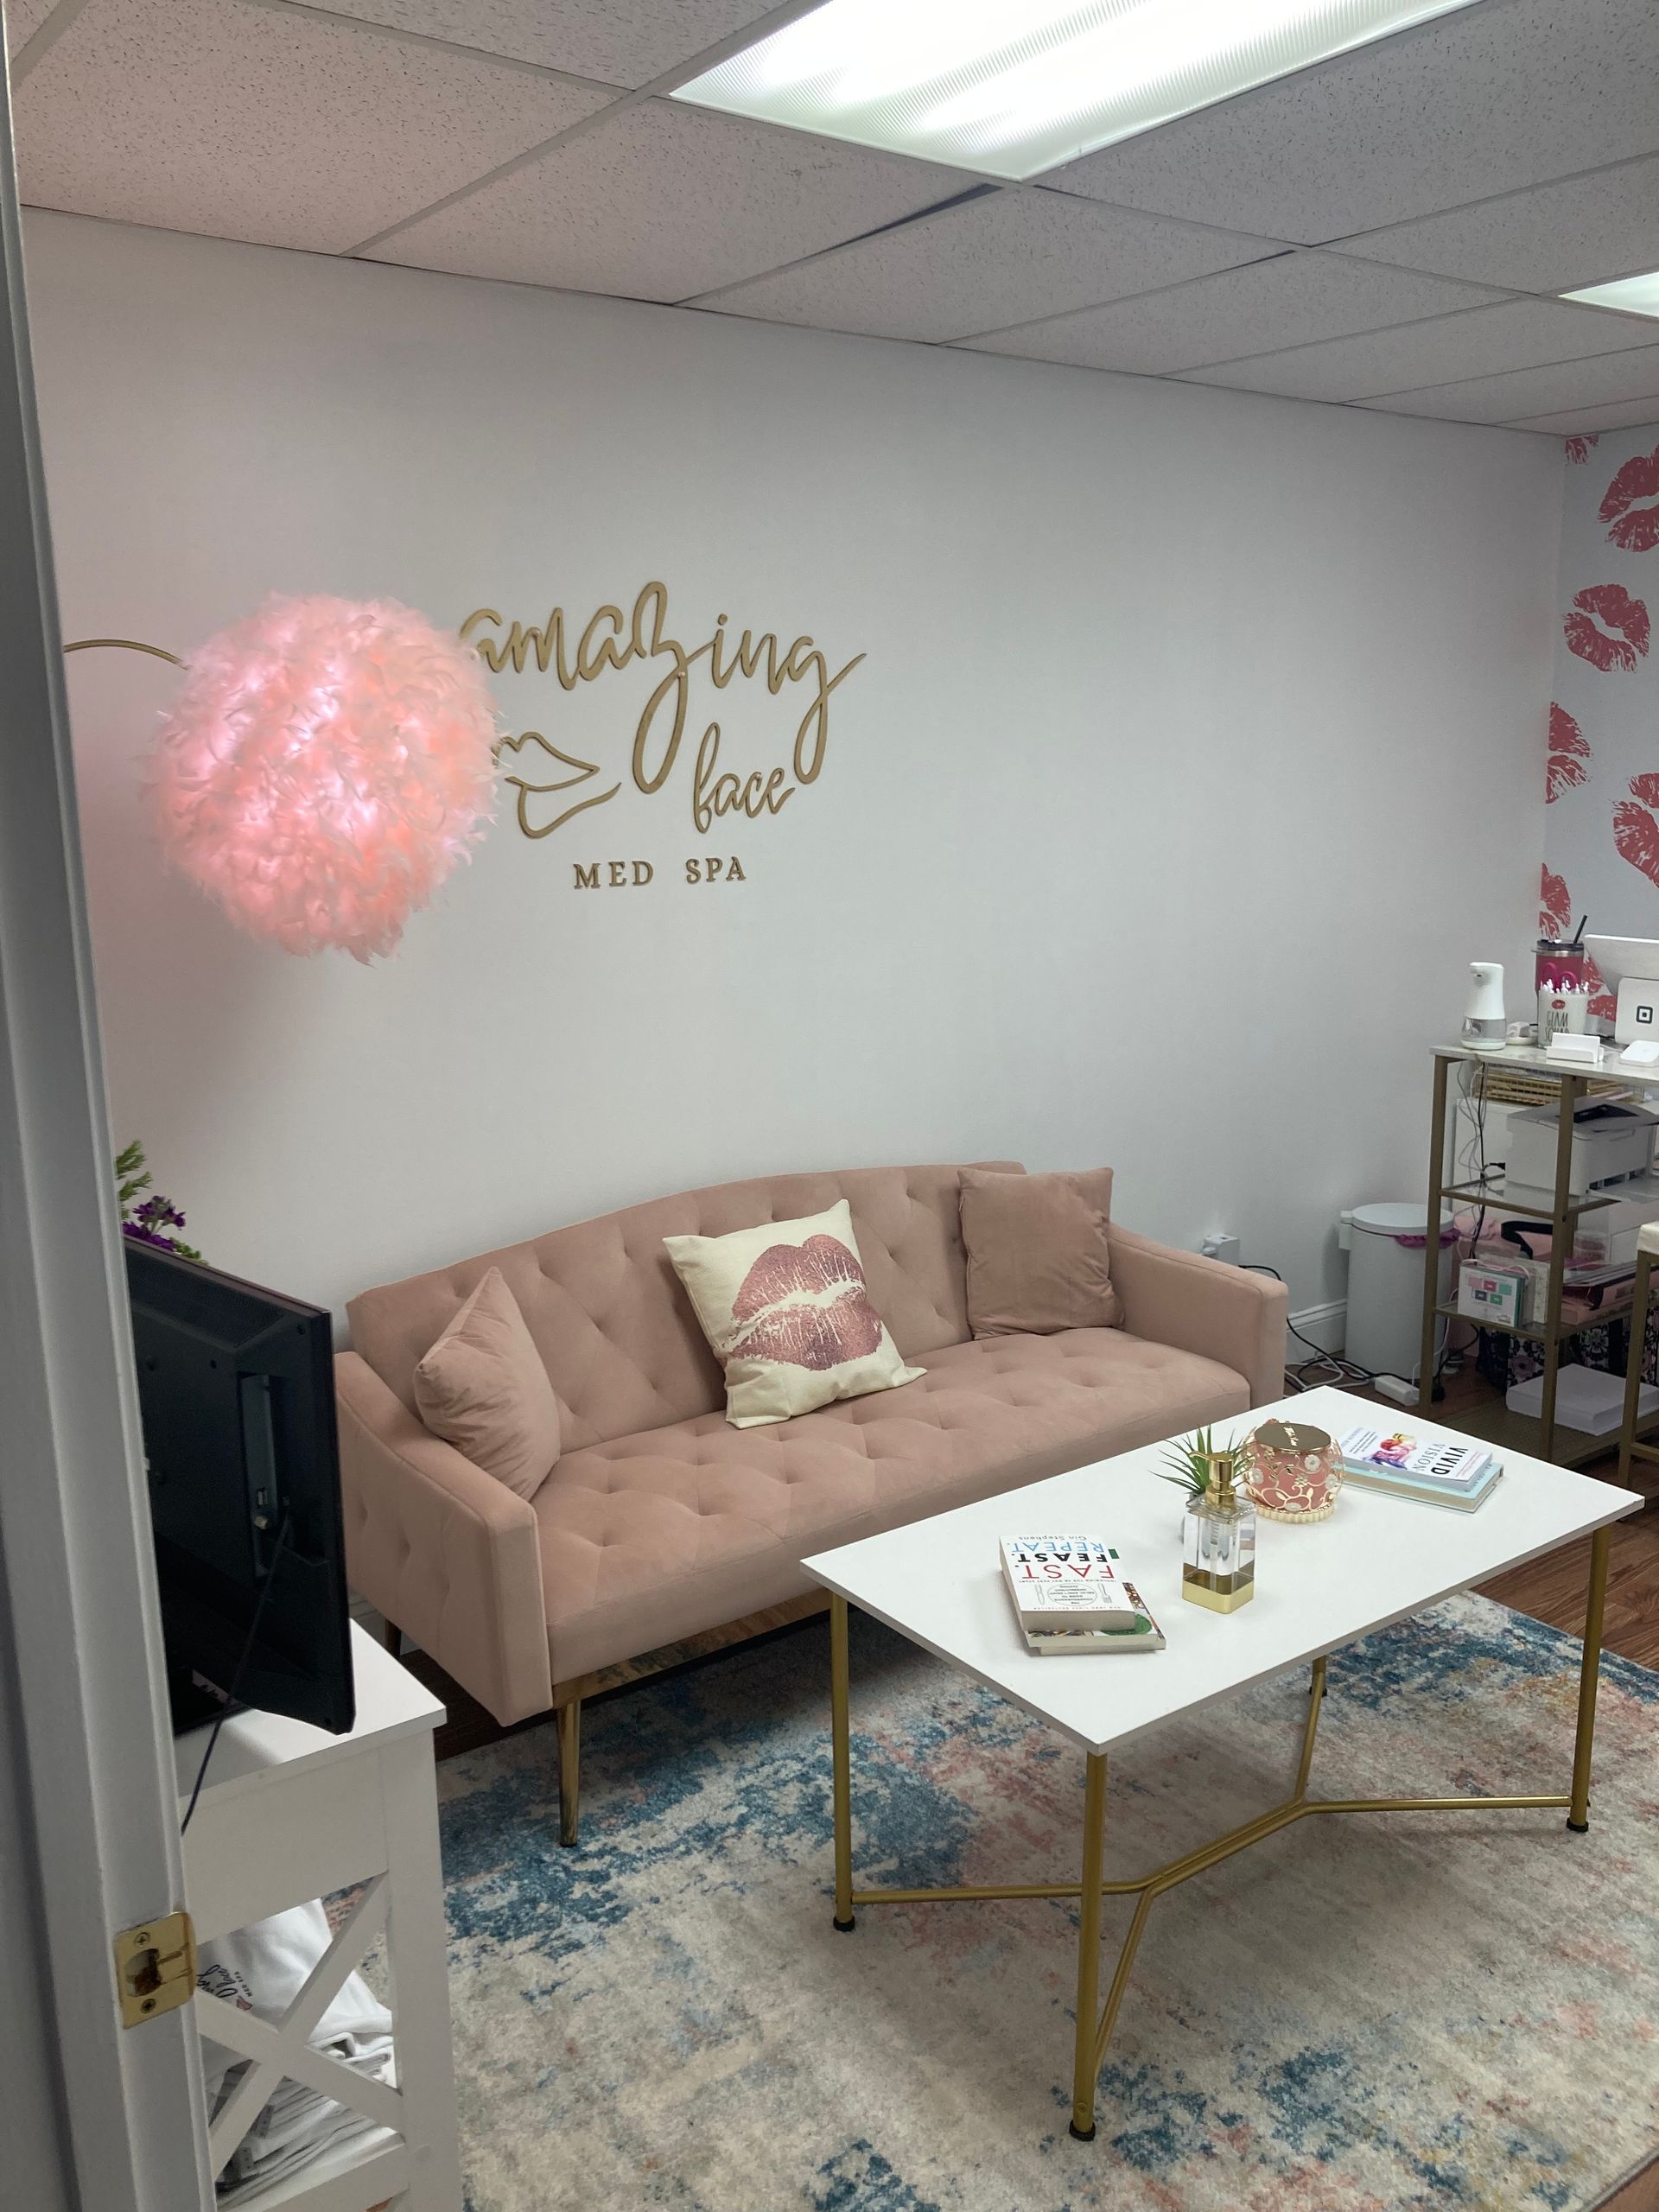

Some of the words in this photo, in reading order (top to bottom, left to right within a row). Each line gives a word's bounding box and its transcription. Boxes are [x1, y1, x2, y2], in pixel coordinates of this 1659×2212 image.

[693, 722, 796, 834] face
[573, 861, 654, 890] MED
[685, 855, 747, 885] SPA
[1412, 1443, 1446, 1472] VISION
[1430, 1446, 1469, 1475] VIVID
[1007, 1541, 1105, 1553] REPEAT.
[1011, 1553, 1109, 1563] FEAST.
[1014, 1564, 1115, 1580] FAST.
